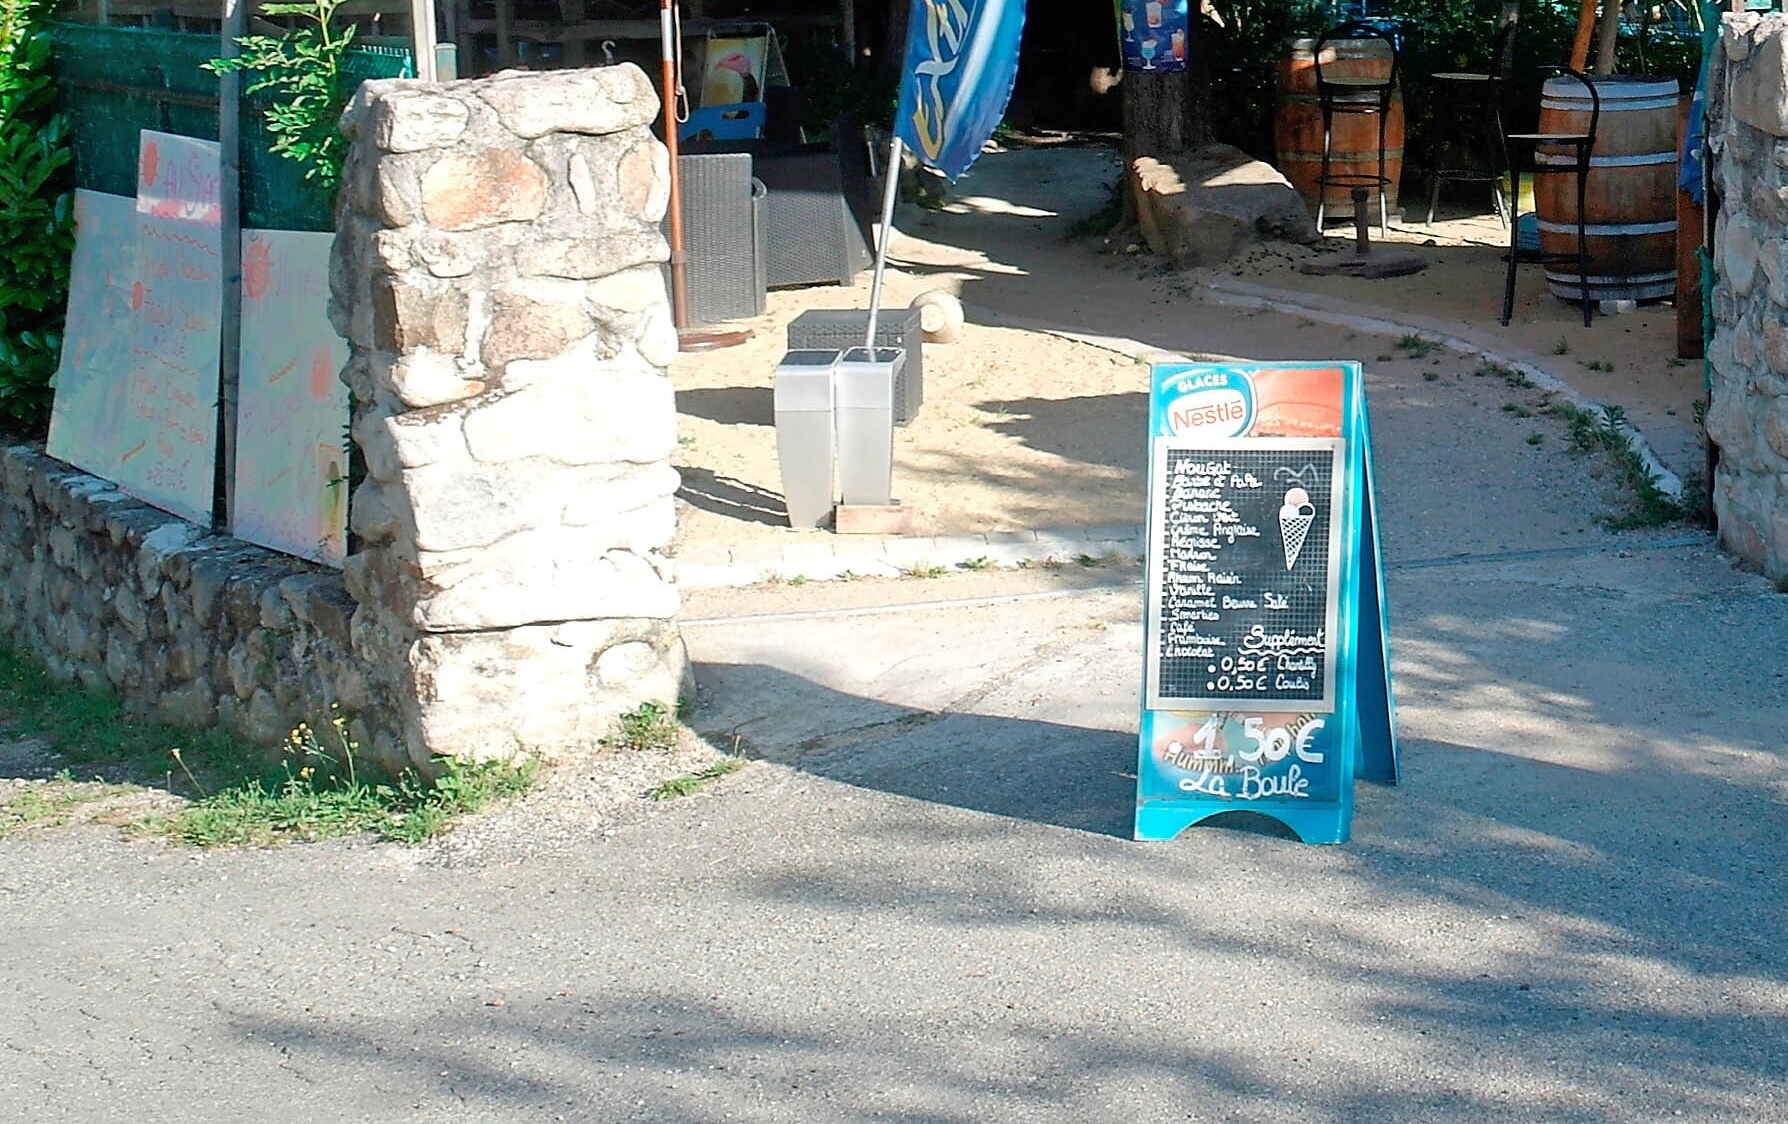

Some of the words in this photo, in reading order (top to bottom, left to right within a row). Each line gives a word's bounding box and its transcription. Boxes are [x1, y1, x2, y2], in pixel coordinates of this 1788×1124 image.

[1177, 373, 1228, 393] GLACES
[1173, 399, 1244, 430] Nestlé
[1169, 620, 1196, 636] Café
[1235, 764, 1310, 800] Boule
